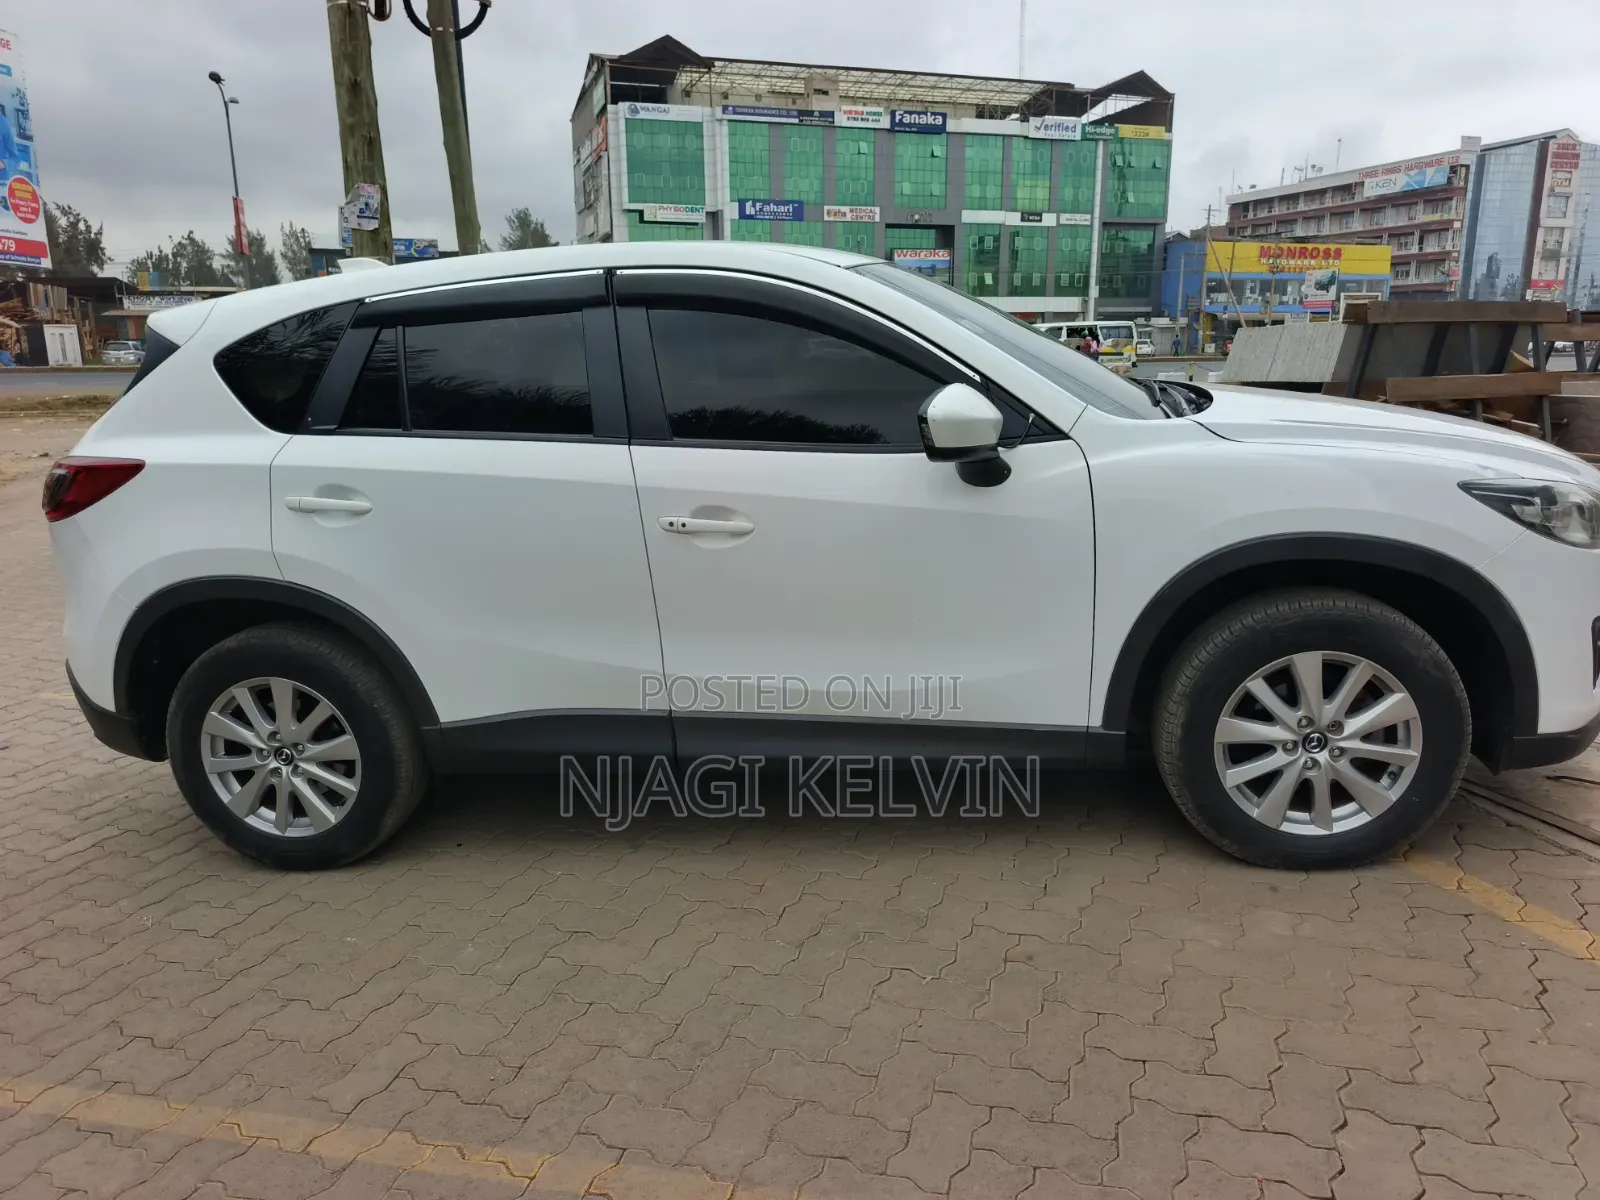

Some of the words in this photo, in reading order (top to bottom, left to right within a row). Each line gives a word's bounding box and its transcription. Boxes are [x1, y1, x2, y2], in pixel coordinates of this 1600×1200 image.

[895, 110, 943, 126] Fanaka
[1358, 169, 1379, 181] THREE
[1403, 157, 1445, 173] HARDWARE
[1552, 179, 1570, 187] GYM
[755, 202, 793, 212] Fahari
[849, 207, 877, 215] MEDICAL
[895, 249, 952, 259] waraka
